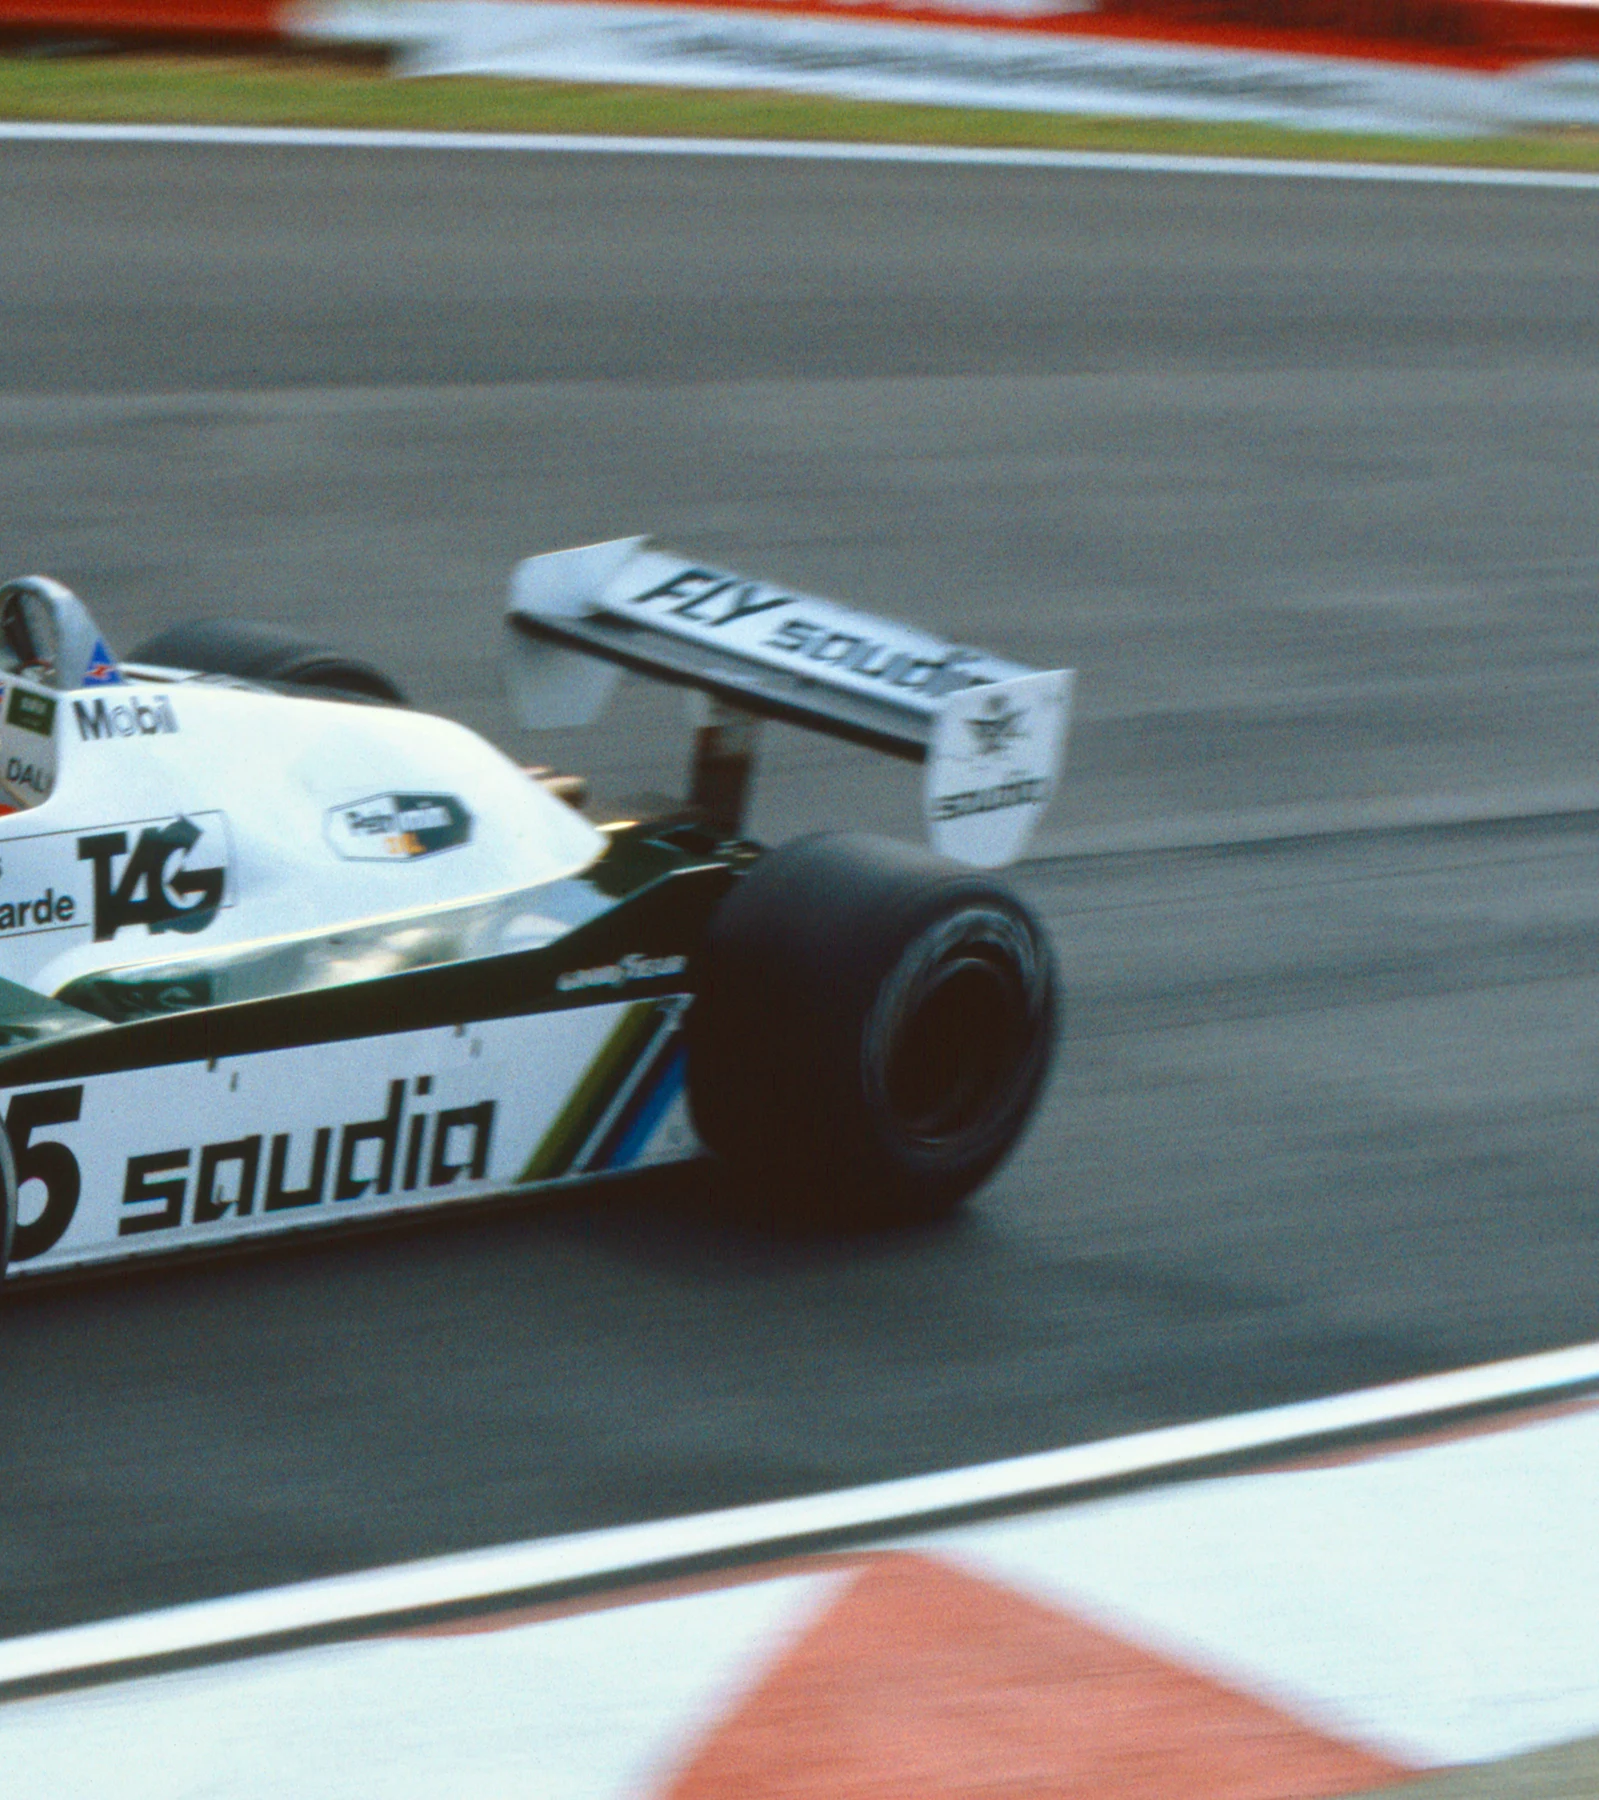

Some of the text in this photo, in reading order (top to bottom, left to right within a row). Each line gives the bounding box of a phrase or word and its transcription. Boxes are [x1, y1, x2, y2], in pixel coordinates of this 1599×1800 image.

[631, 568, 794, 627] FLY
[73, 695, 179, 741] Mobil
[77, 813, 226, 943] TAG
[118, 1074, 497, 1236] saudia
